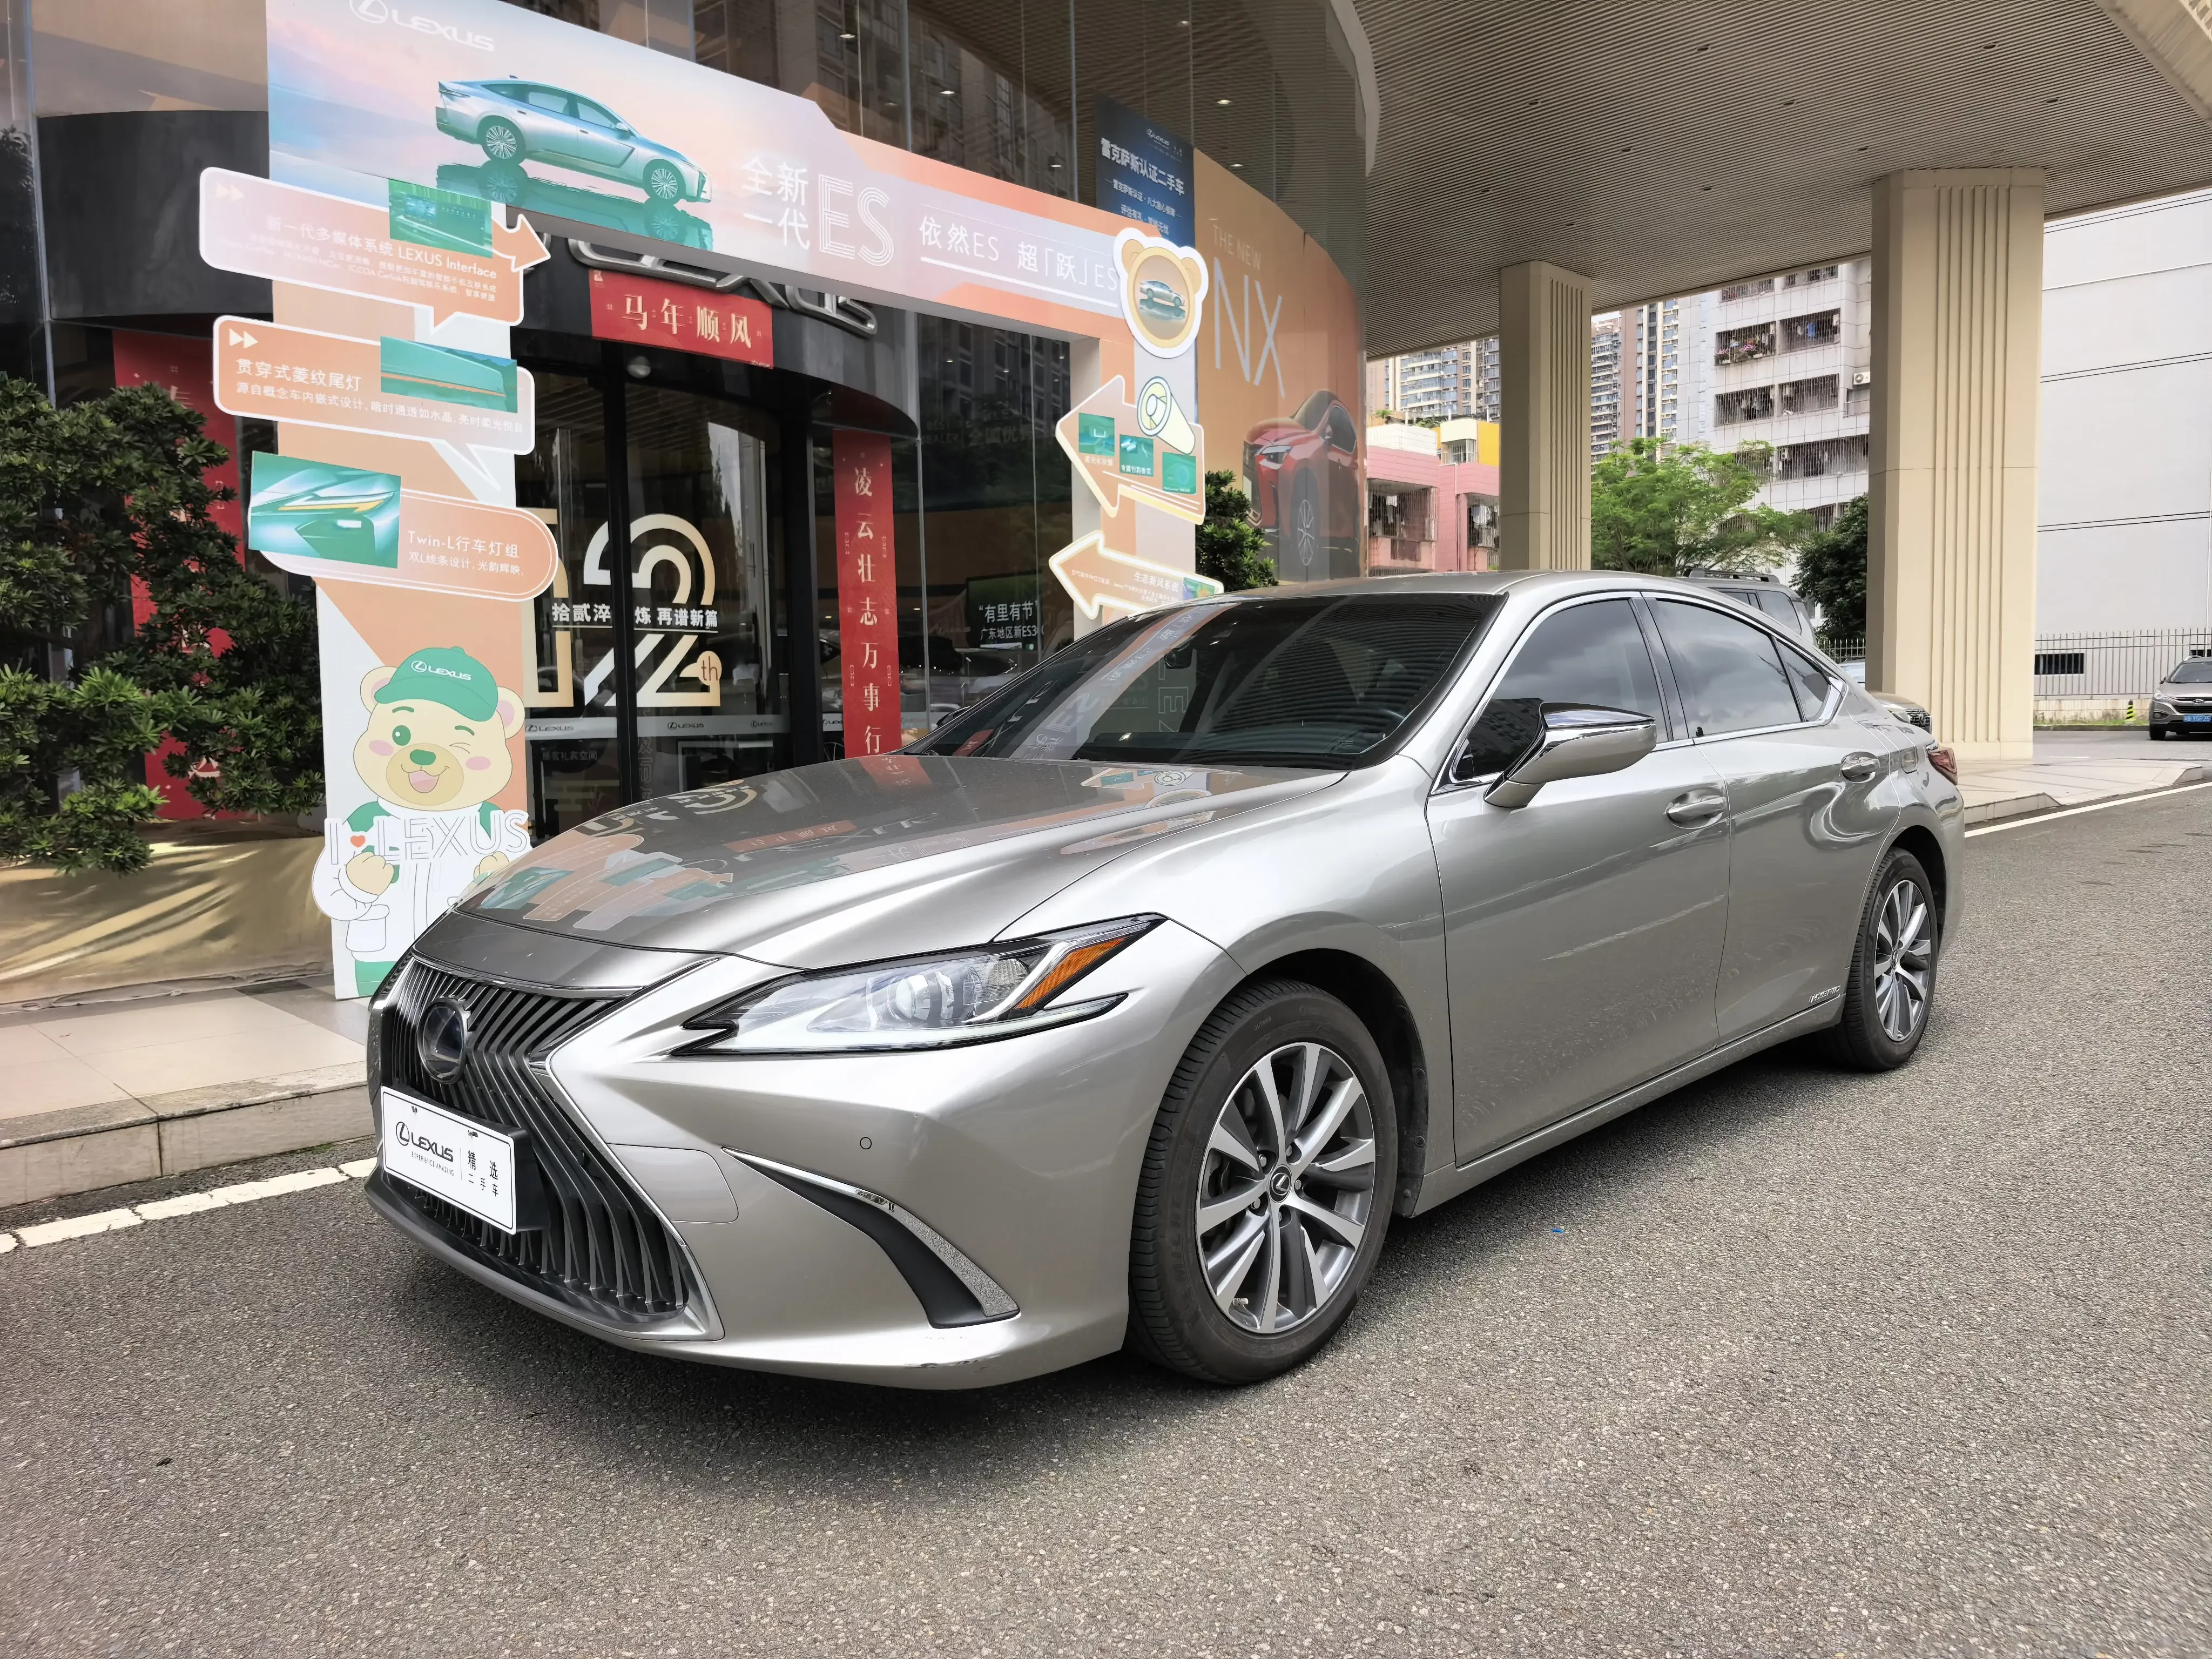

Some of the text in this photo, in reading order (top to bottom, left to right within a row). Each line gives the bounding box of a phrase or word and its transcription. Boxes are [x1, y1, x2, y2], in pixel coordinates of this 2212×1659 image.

[392, 9, 495, 52] LEXUS
[1101, 137, 1185, 195] 雷克萨斯认证二手车
[818, 173, 894, 267] ES
[919, 214, 1000, 261] 依然ES
[267, 215, 394, 257] 新一代多媒体系统
[398, 245, 443, 267] LEXUS
[447, 257, 497, 279] Interface
[1213, 224, 1262, 271] THE NEW
[622, 293, 752, 349] 马年顺风
[1213, 256, 1285, 399] NX
[235, 358, 362, 392] 贯穿式菱纹尾灯
[408, 530, 520, 558] Twin-L行车灯组
[657, 606, 719, 628] 再谱新篇
[854, 467, 882, 755] 凌云壮志万事行
[427, 665, 471, 682] LEXUS
[377, 812, 529, 861] LEXUS
[411, 1132, 454, 1162] LEXUS
[412, 1151, 454, 1176] EXPERIENCE AMAZING
[468, 1150, 498, 1181] 精选
[468, 1174, 498, 1197] 二手车
